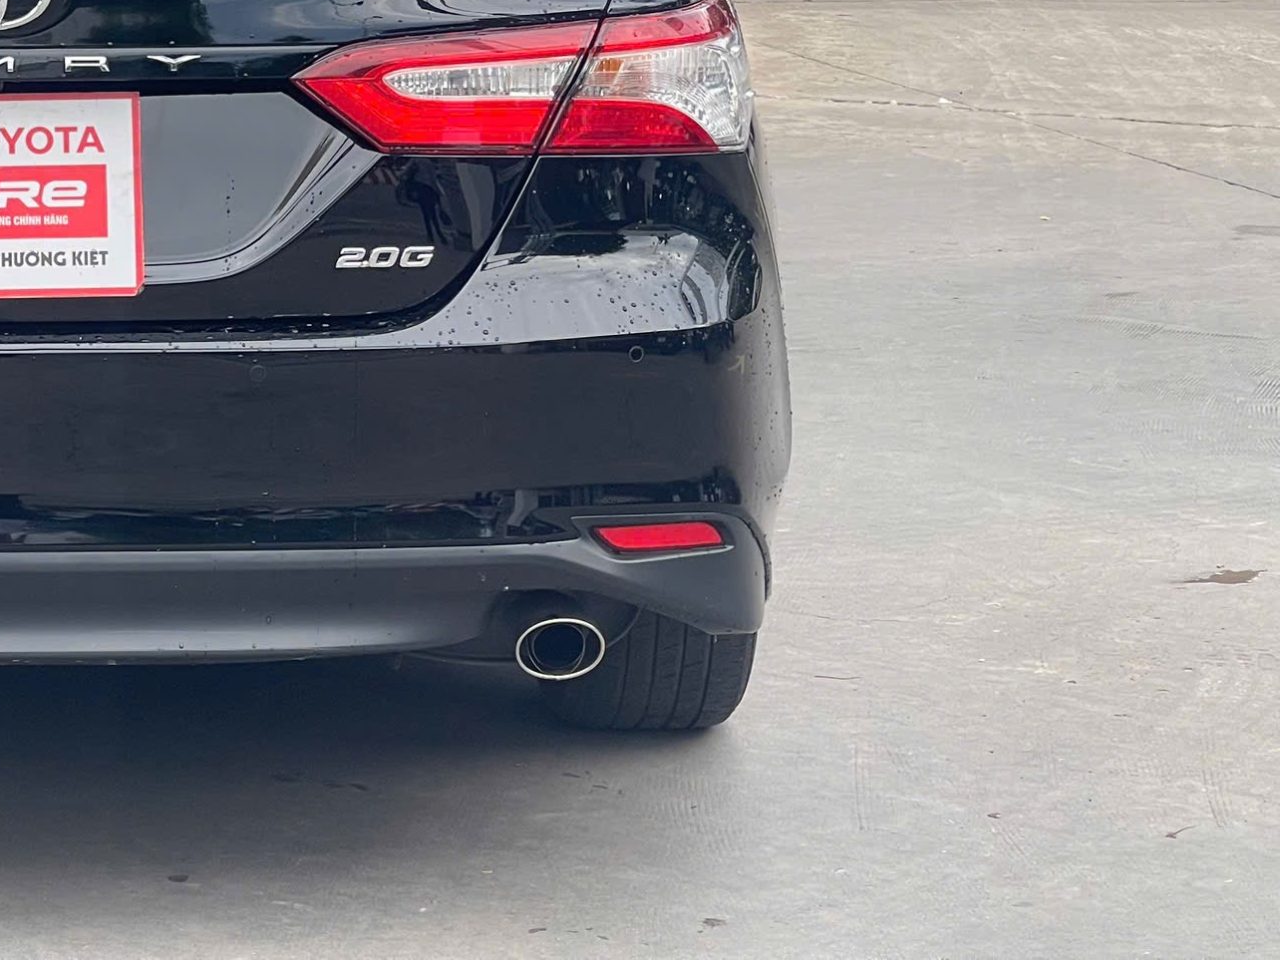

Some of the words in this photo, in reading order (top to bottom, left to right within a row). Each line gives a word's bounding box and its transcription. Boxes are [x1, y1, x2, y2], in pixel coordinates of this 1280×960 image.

[13, 214, 41, 226] CHÍNH
[71, 248, 109, 268] KIỆT
[335, 246, 435, 269] 2.0G
